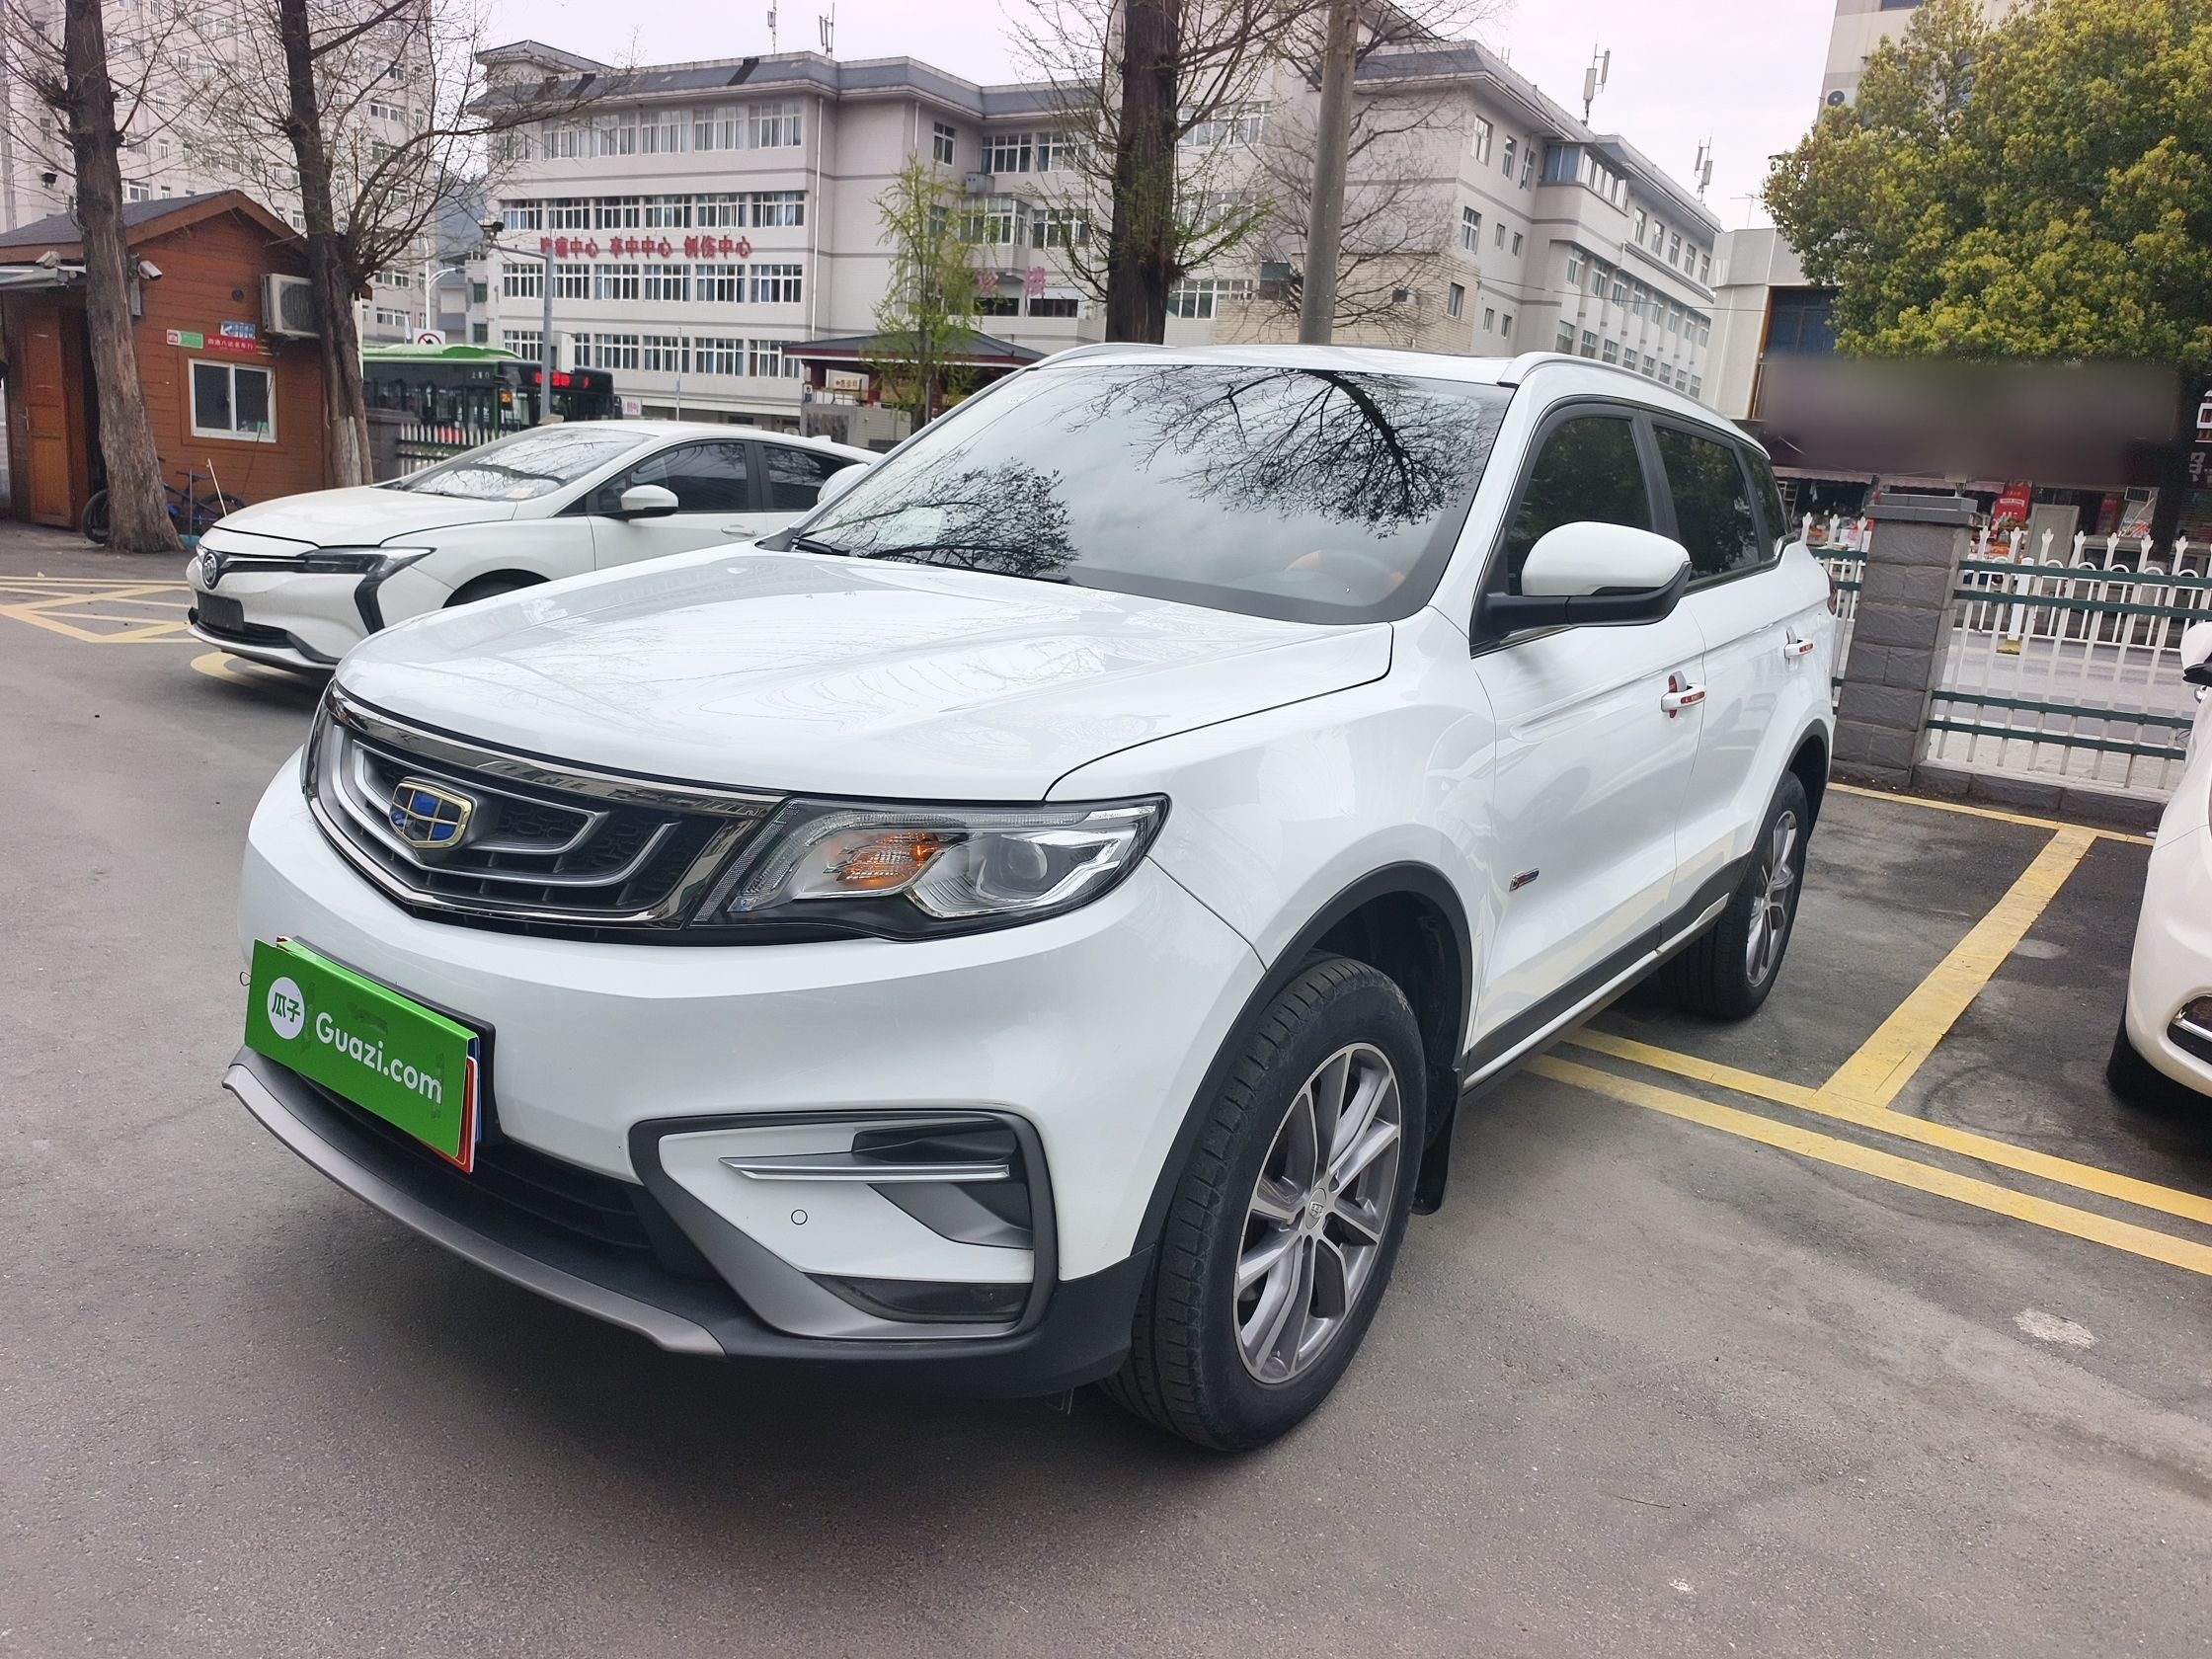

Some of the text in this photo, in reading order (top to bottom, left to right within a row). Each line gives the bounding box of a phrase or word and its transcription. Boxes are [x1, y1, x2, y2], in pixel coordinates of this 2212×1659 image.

[609, 236, 672, 260] 卒中中心
[684, 235, 752, 260] 创伤中心
[271, 991, 301, 1023] 瓜子
[315, 1011, 443, 1104] Guazi.com
